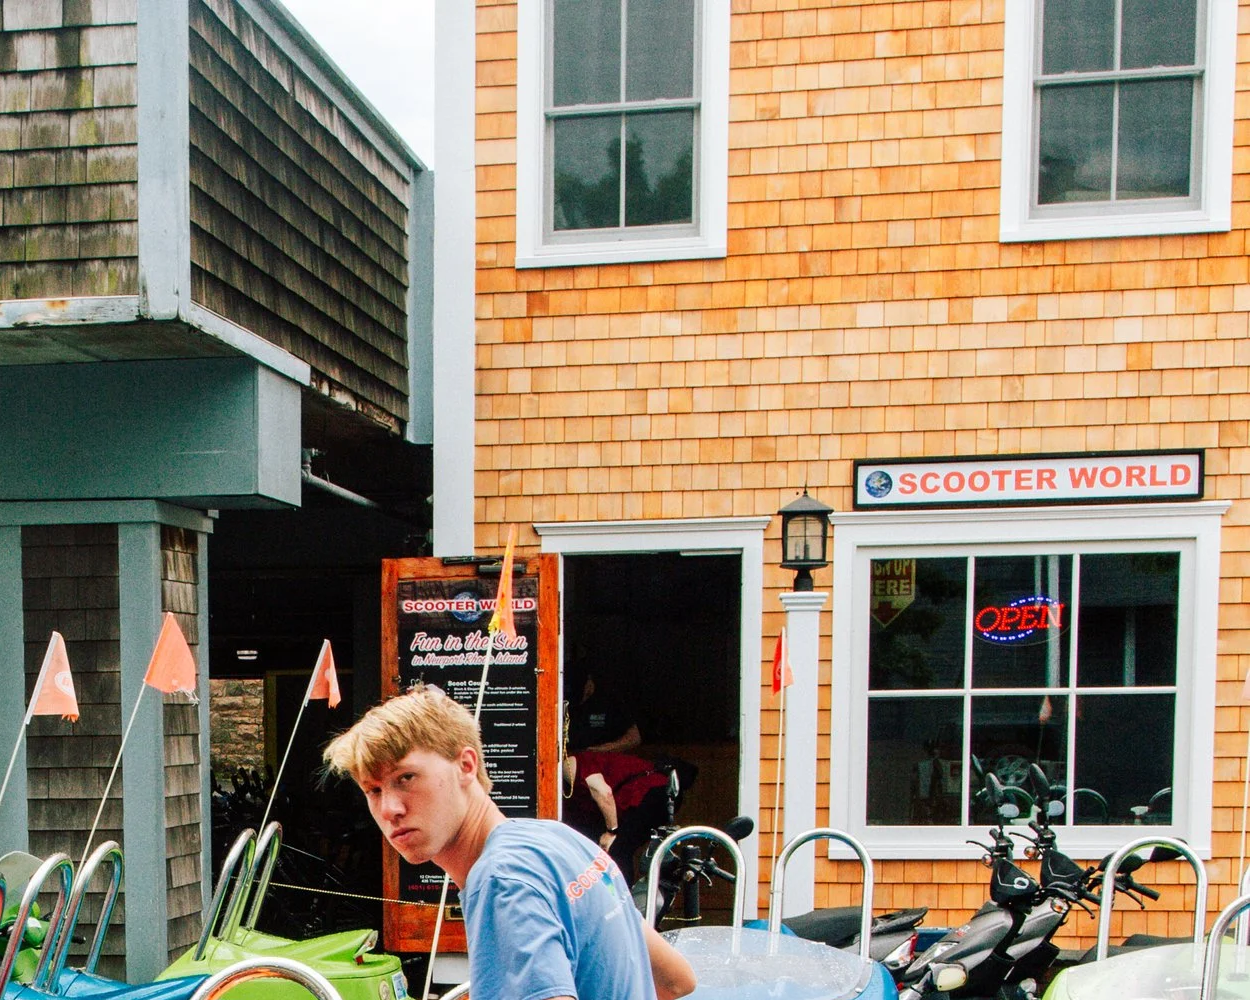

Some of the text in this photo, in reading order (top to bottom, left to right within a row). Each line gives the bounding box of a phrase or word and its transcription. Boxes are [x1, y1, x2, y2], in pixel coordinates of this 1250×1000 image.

[898, 463, 1192, 495] SCOOTER WORLD
[874, 579, 911, 596] ERE
[404, 599, 535, 612] SCOOTER WLD
[975, 603, 1065, 632] OPEN
[410, 630, 528, 651] Fun in the Sun
[412, 651, 528, 669] in Newport Rhoe Island
